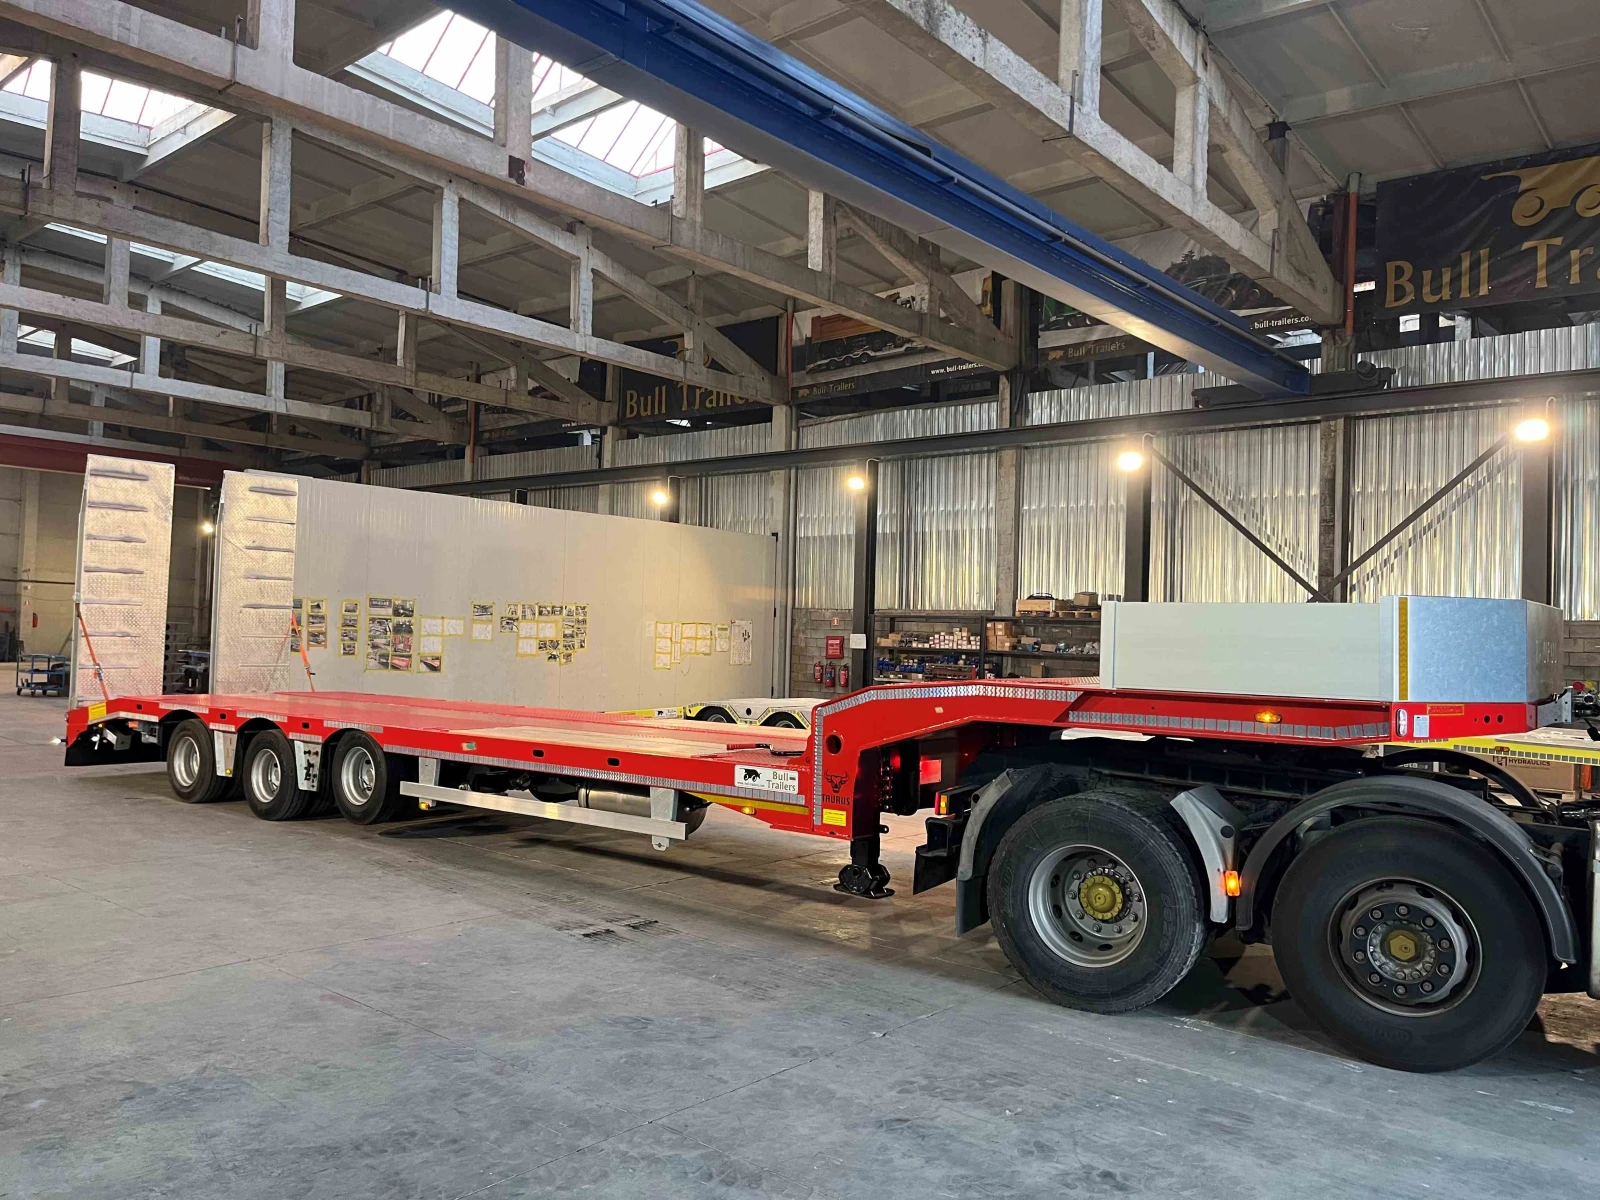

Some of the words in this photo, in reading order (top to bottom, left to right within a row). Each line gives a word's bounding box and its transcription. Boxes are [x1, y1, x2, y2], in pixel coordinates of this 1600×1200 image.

[1385, 248, 1490, 308] Bull
[1521, 236, 1600, 289] Tr
[1068, 346, 1086, 358] Bull
[1088, 341, 1126, 354] Trailers
[812, 386, 826, 396] Bull
[828, 382, 855, 393] Trailers
[625, 385, 667, 418] Bull
[1508, 758, 1551, 767] HYDRAULICS
[772, 771, 789, 781] Bull
[766, 780, 796, 791] Trailers
[822, 794, 850, 806] TAURUS
